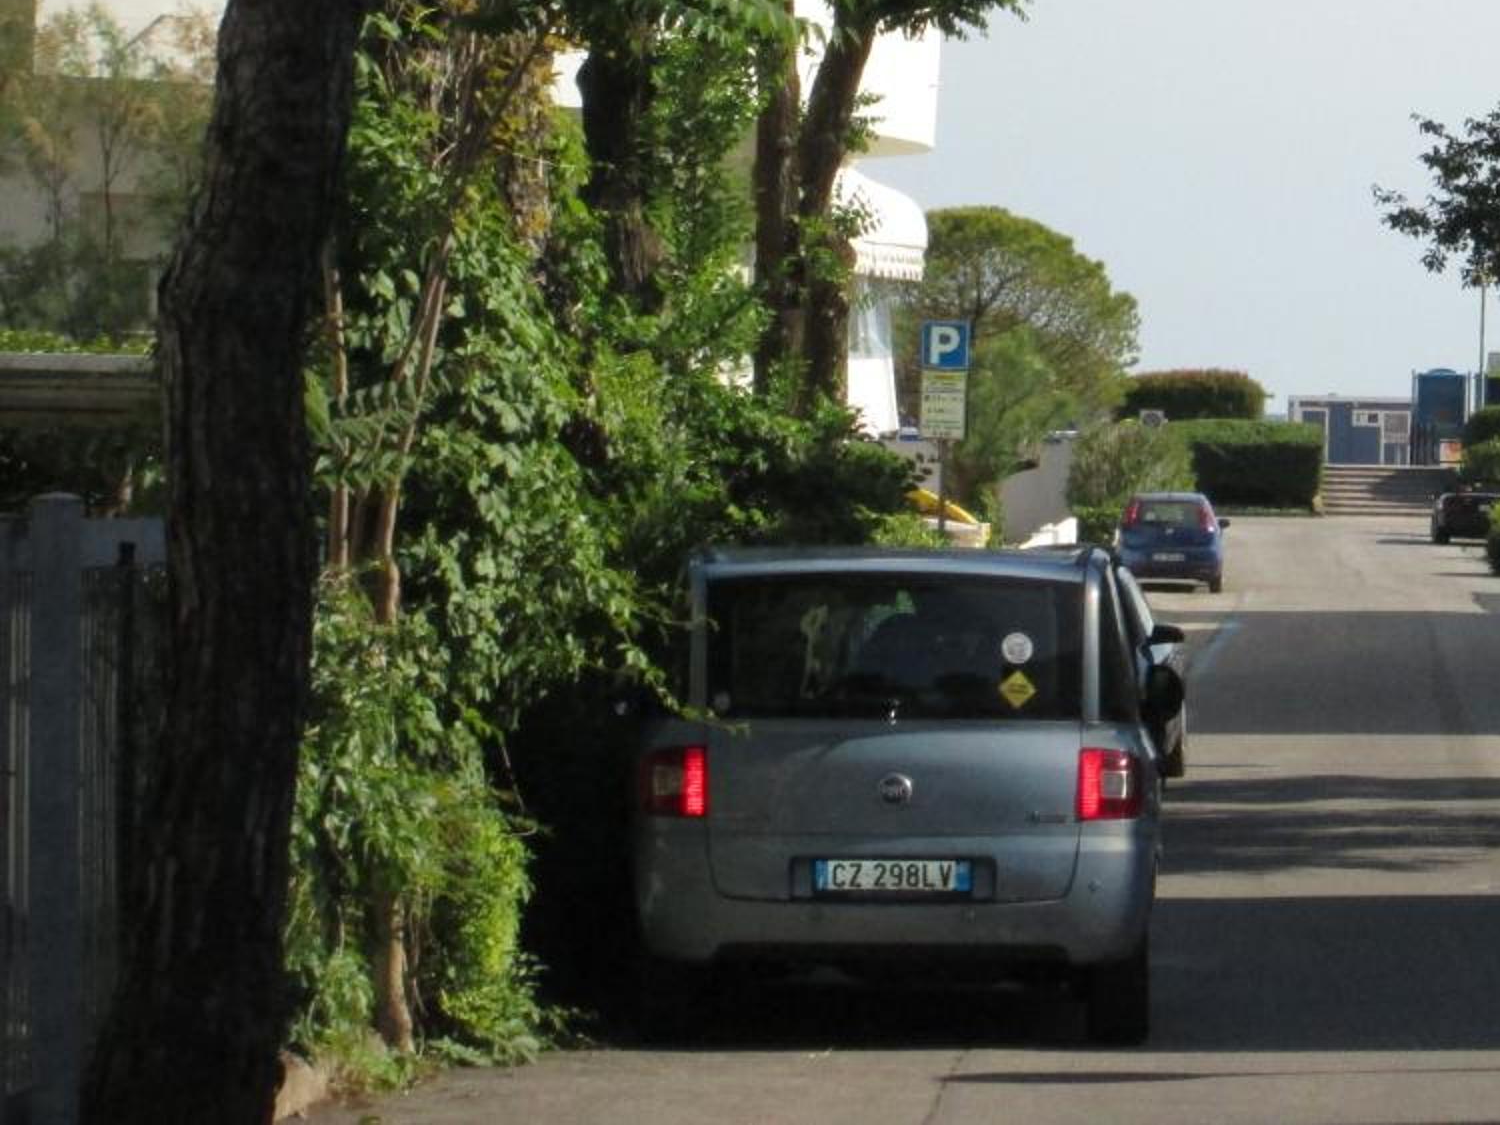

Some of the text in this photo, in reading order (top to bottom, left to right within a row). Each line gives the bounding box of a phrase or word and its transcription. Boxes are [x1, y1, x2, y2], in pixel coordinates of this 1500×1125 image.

[930, 325, 960, 364] P
[832, 862, 953, 888] CZ 298LV
